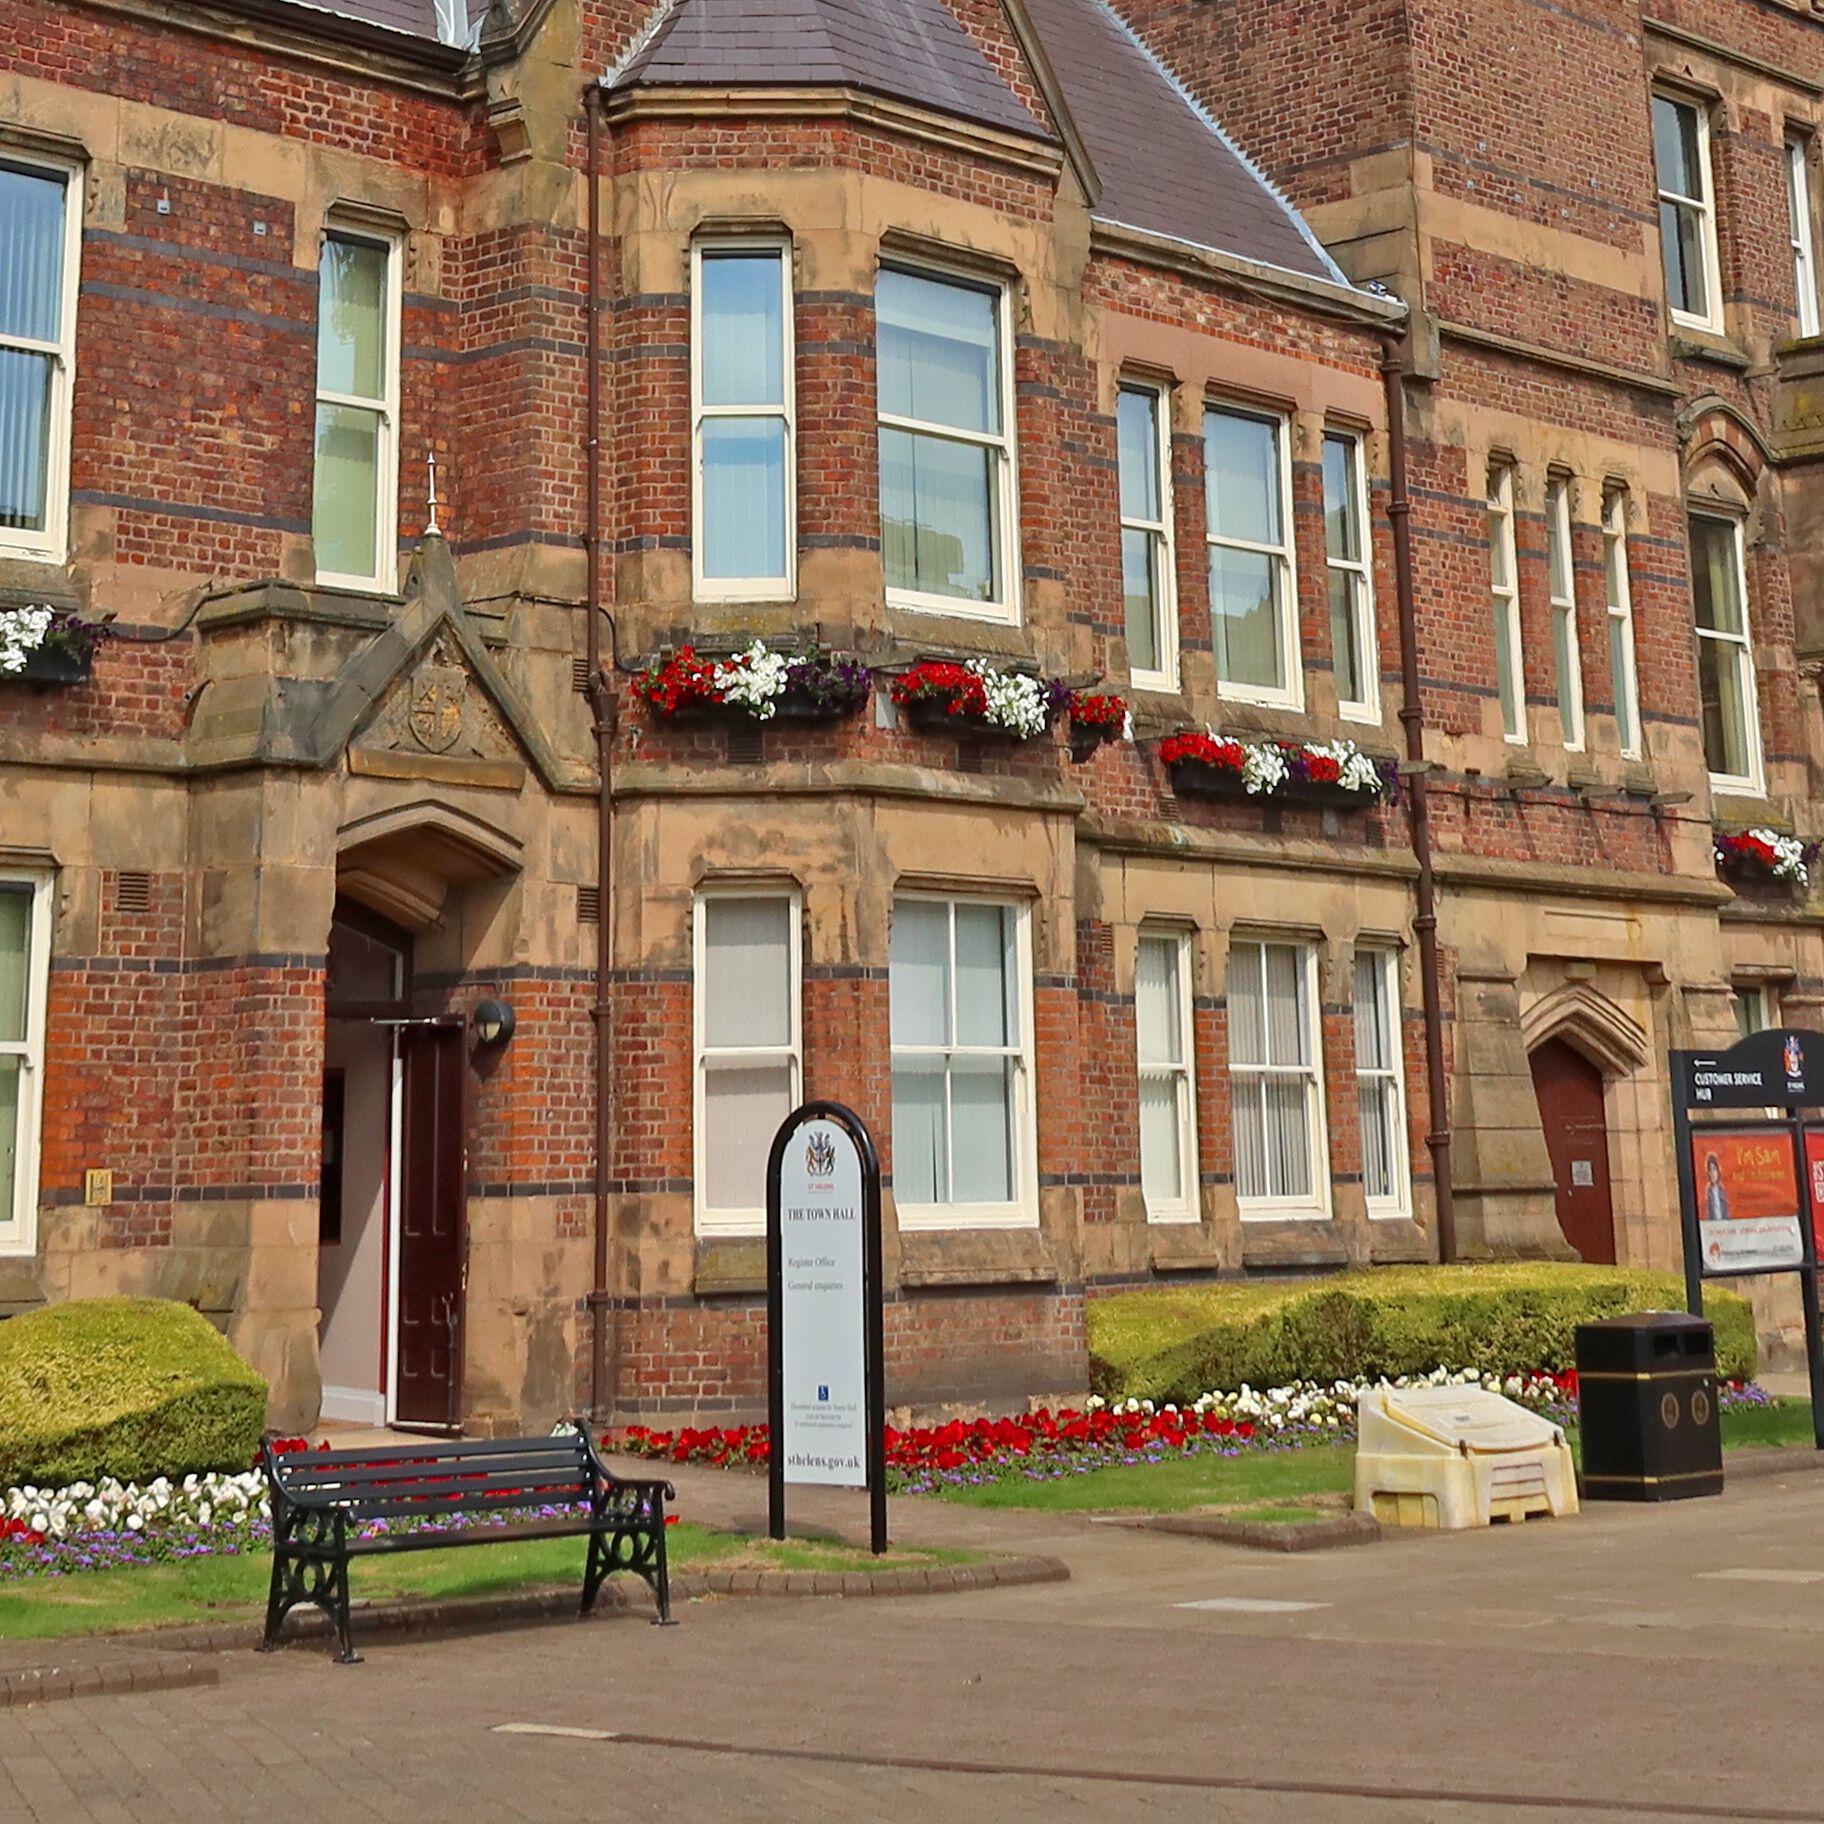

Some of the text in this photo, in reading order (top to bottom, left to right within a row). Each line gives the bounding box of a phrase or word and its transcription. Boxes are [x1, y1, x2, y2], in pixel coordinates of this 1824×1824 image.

[1695, 1072, 1763, 1086] CUSTOMER SERVICE
[1695, 1087, 1712, 1100] HUB
[787, 1207, 855, 1221] THE TOWN HALL
[787, 1452, 861, 1471] sthelens.gov.uk
